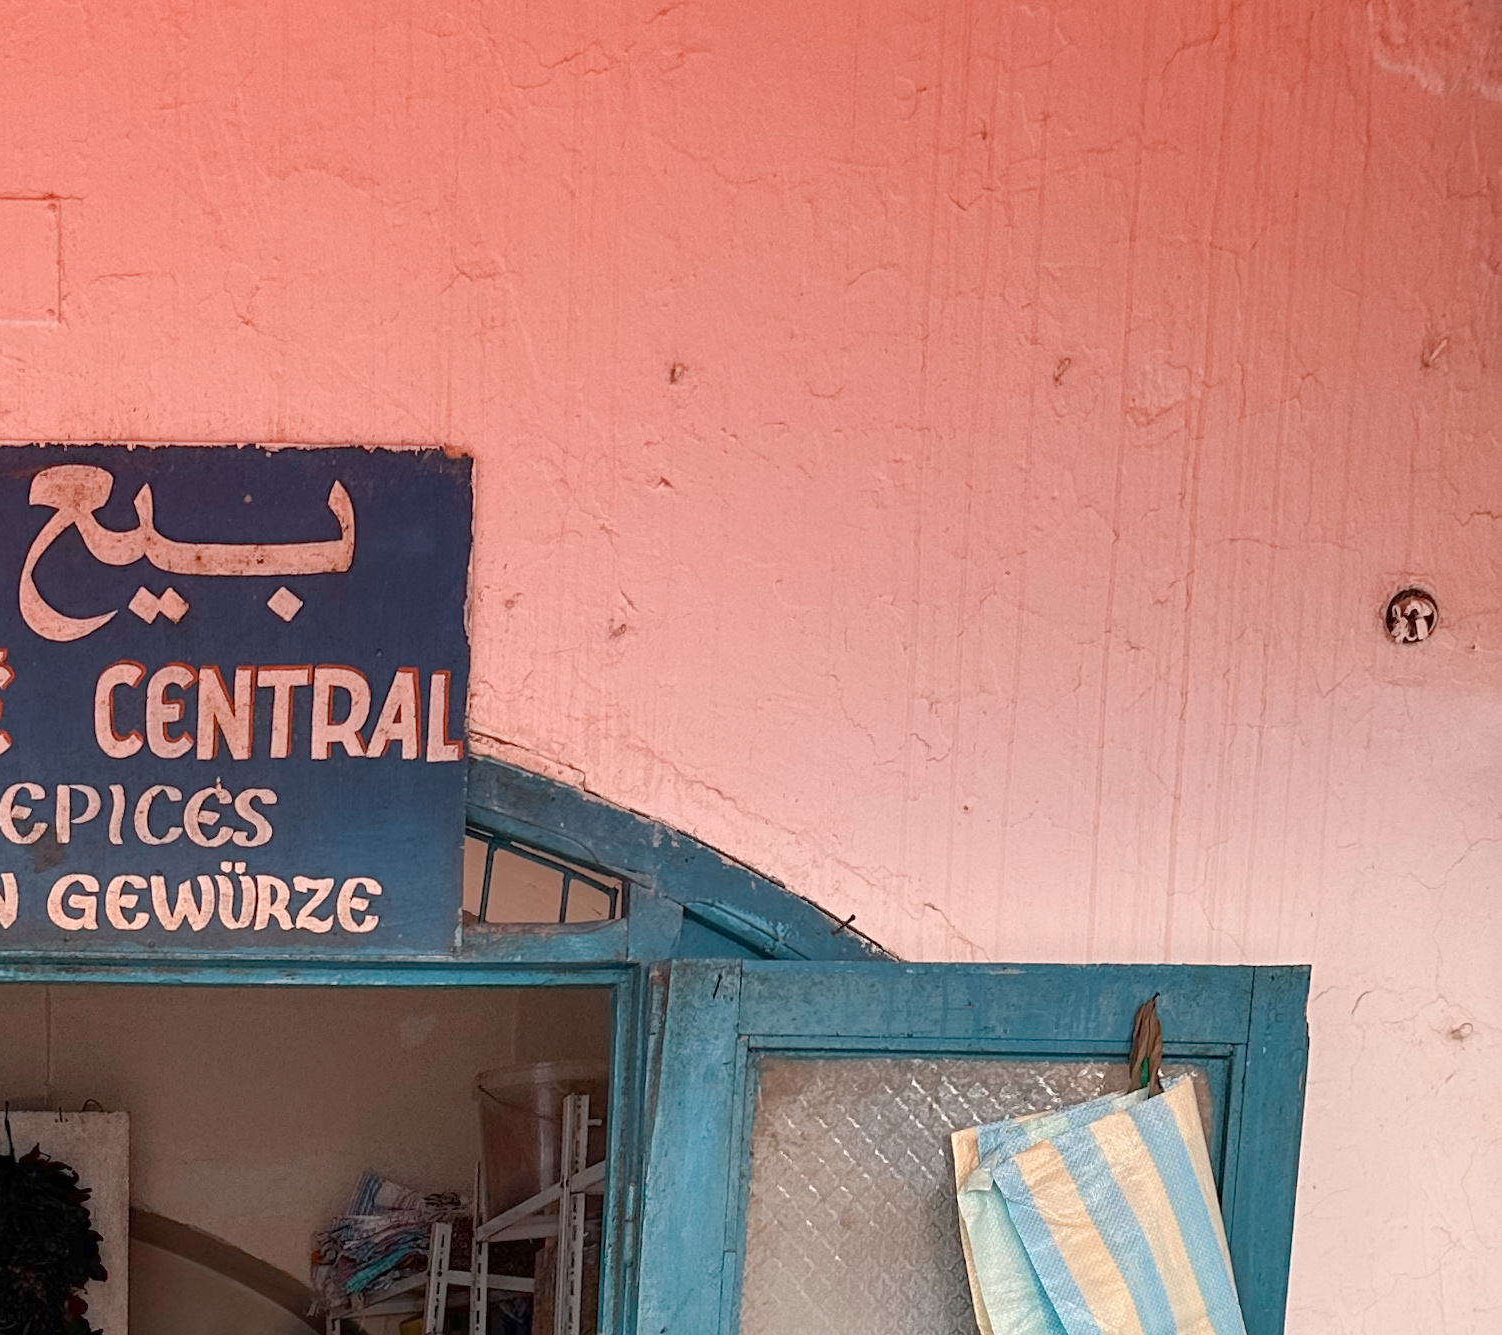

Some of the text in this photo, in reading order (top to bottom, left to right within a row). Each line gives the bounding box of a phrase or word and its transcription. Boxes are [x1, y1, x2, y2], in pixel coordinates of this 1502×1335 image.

[18, 463, 355, 642] بيع
[95, 660, 463, 762] CENTRAL
[47, 861, 383, 932] GEWÜRZE
